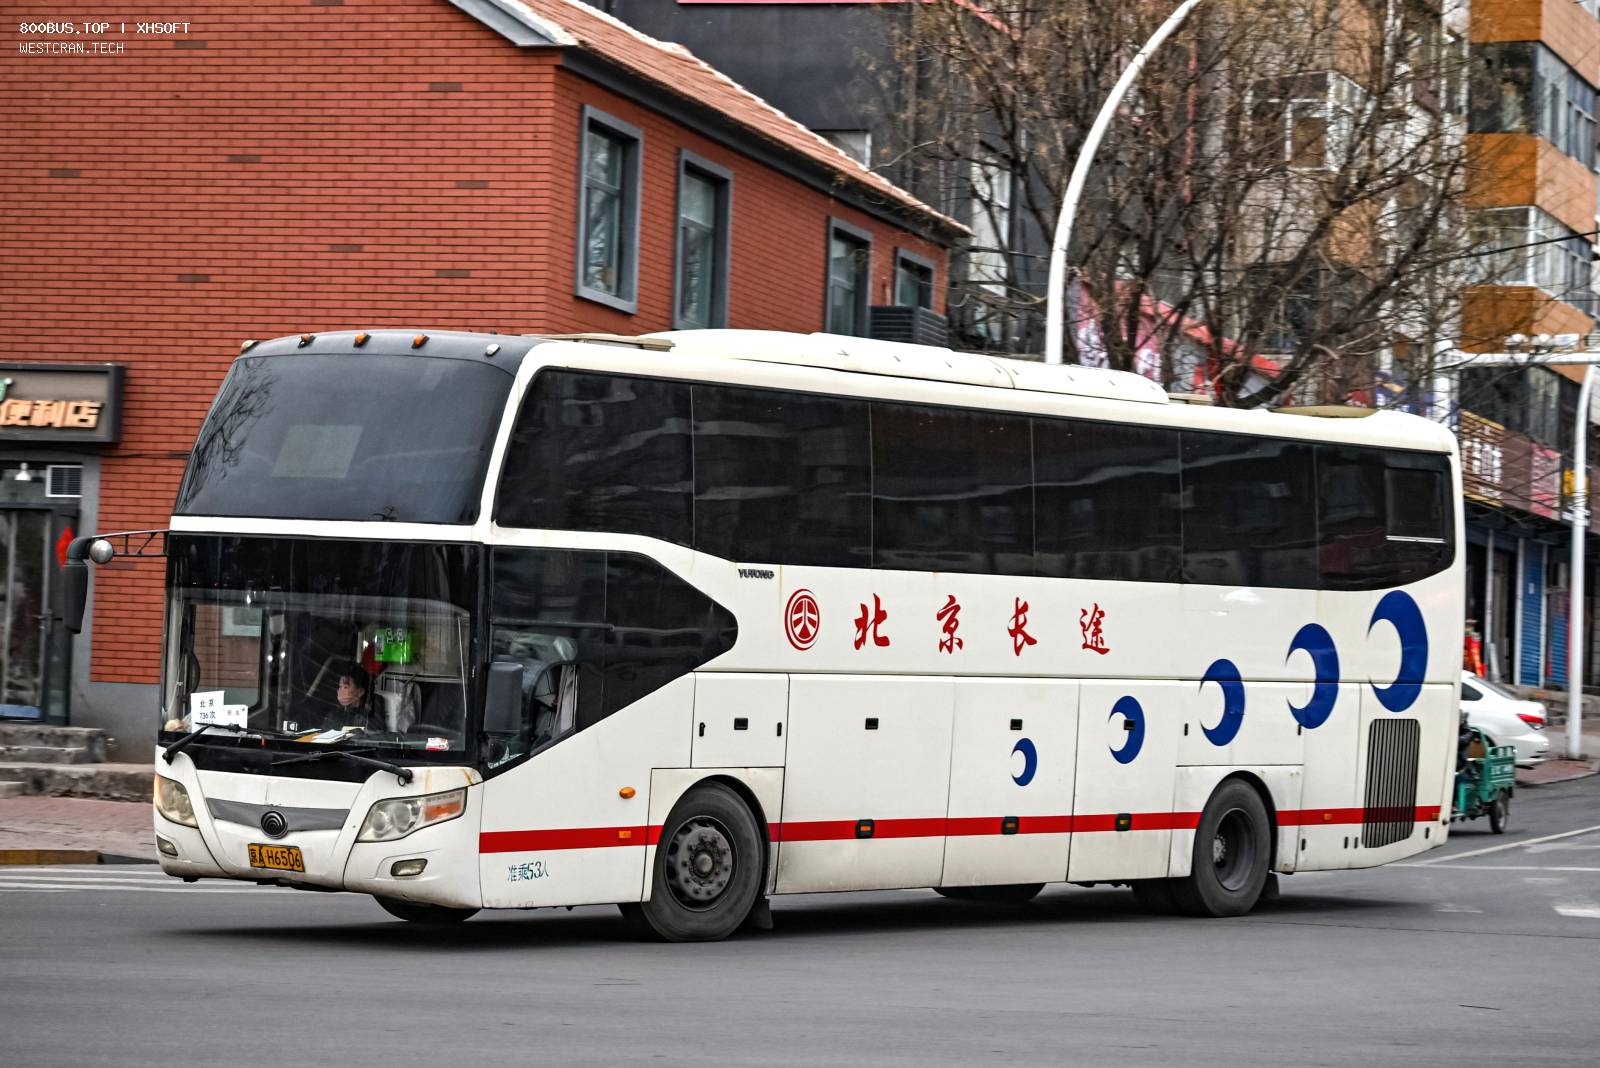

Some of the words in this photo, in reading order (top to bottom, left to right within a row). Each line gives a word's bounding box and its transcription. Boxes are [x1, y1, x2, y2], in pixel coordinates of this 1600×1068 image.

[737, 568, 775, 580] YUTONG
[853, 592, 1111, 656] 北京长途
[507, 860, 549, 882] 准乘53人
